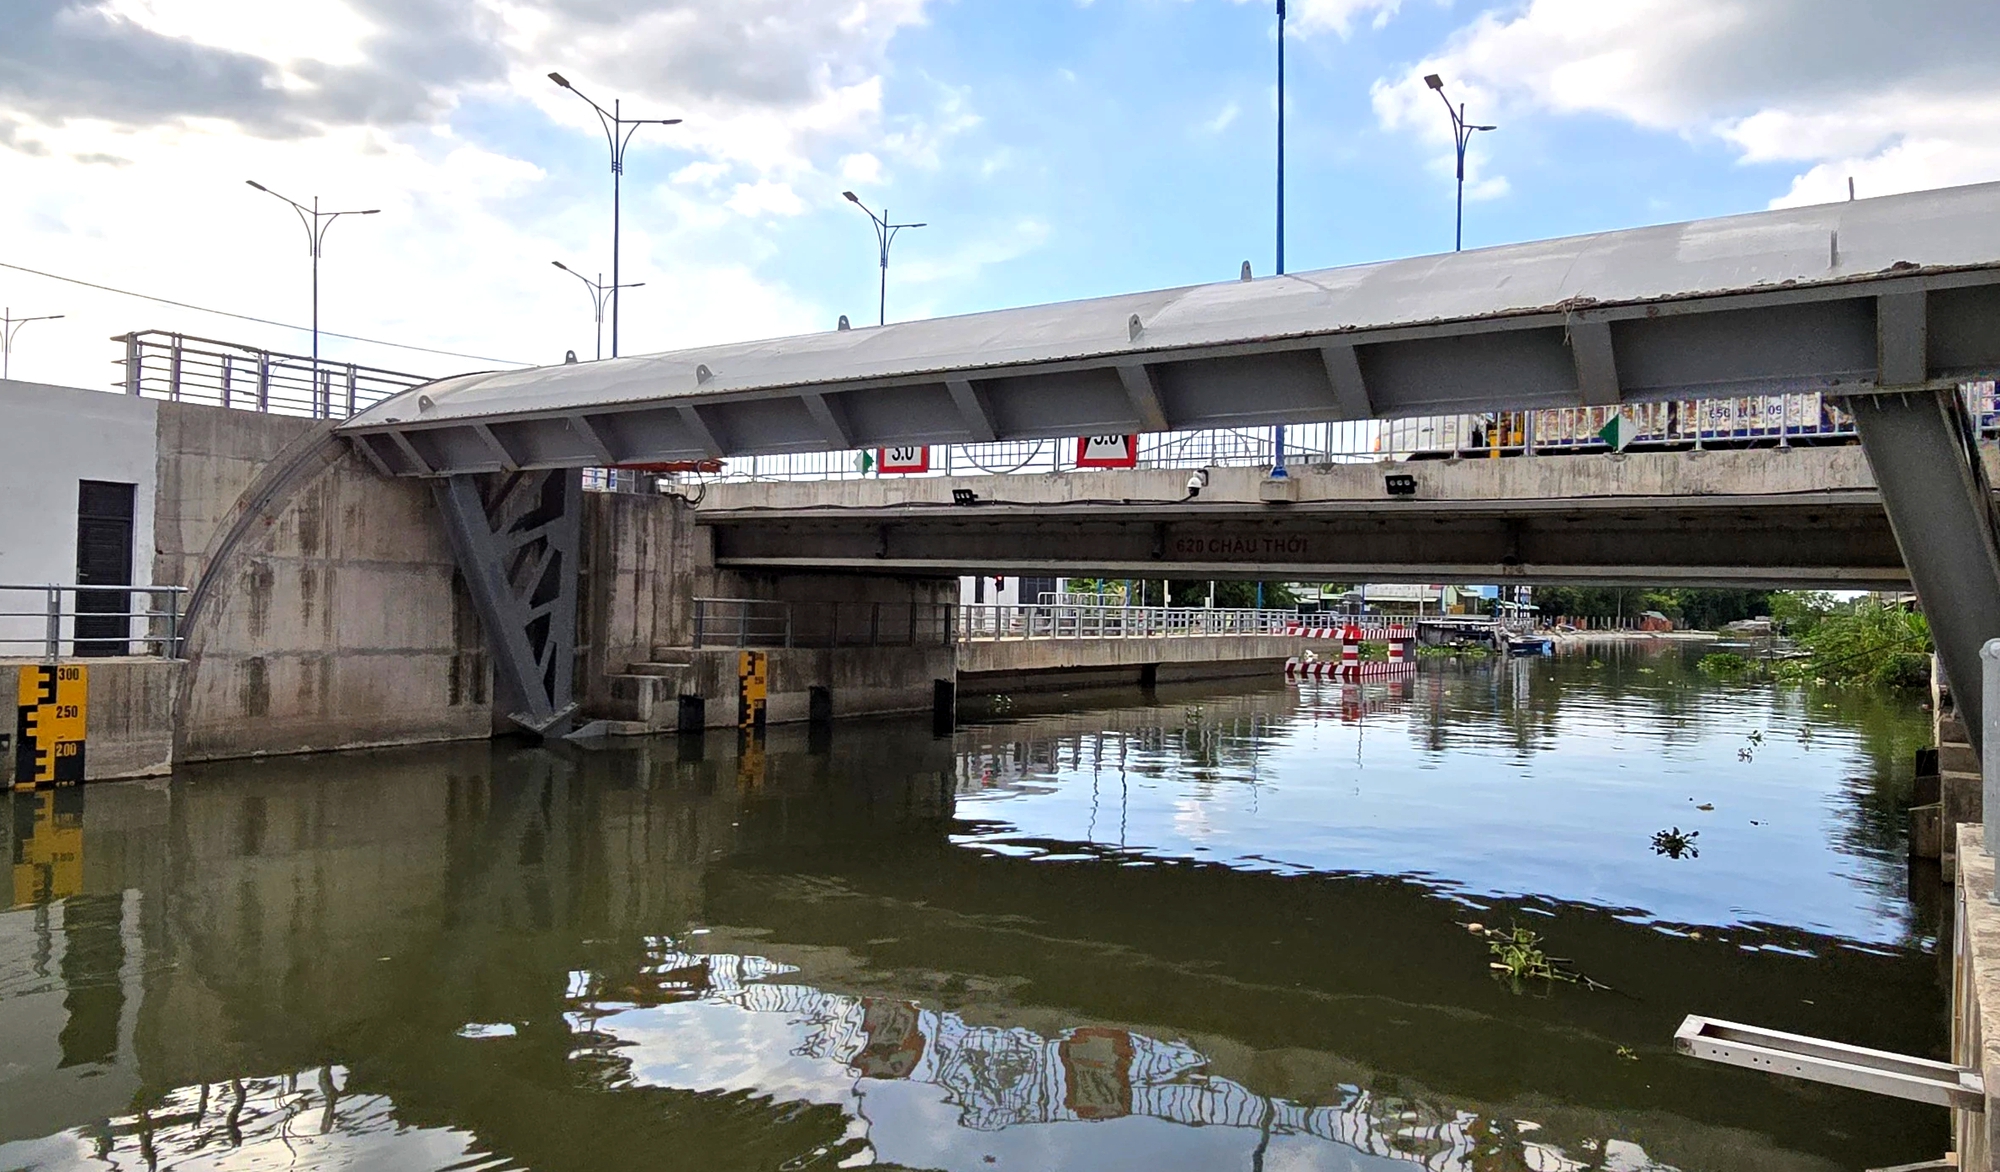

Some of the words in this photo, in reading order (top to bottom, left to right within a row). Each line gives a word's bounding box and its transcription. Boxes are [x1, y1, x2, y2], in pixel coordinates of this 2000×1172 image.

[1176, 539, 1204, 553] 620
[58, 667, 79, 680] 300
[56, 705, 78, 718] 250
[55, 743, 77, 757] 200
